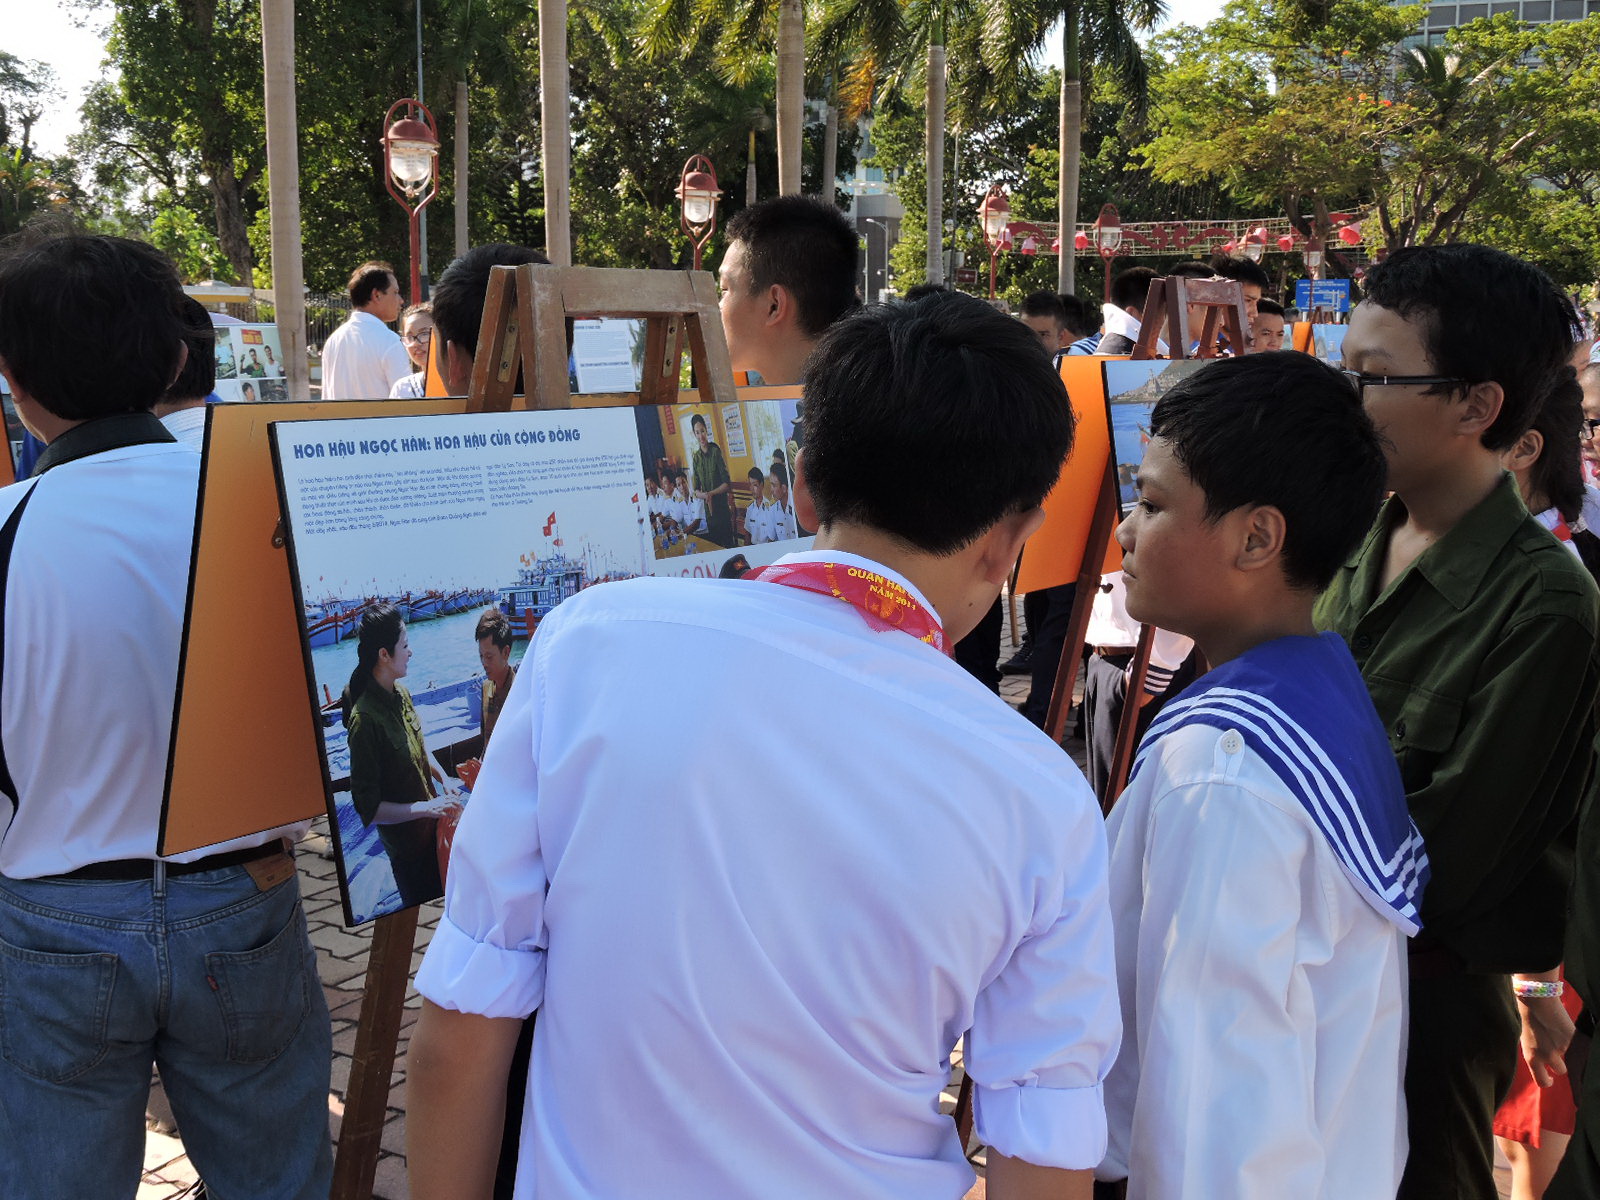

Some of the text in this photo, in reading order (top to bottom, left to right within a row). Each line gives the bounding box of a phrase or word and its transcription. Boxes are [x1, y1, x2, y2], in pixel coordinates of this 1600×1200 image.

[293, 442, 325, 459] HOA
[328, 439, 356, 459] HẬU
[359, 438, 398, 456] NGỌC
[434, 435, 461, 450] HOA
[463, 431, 488, 450] HẬU
[490, 428, 512, 446] CỦA
[514, 429, 546, 447] CỘNG
